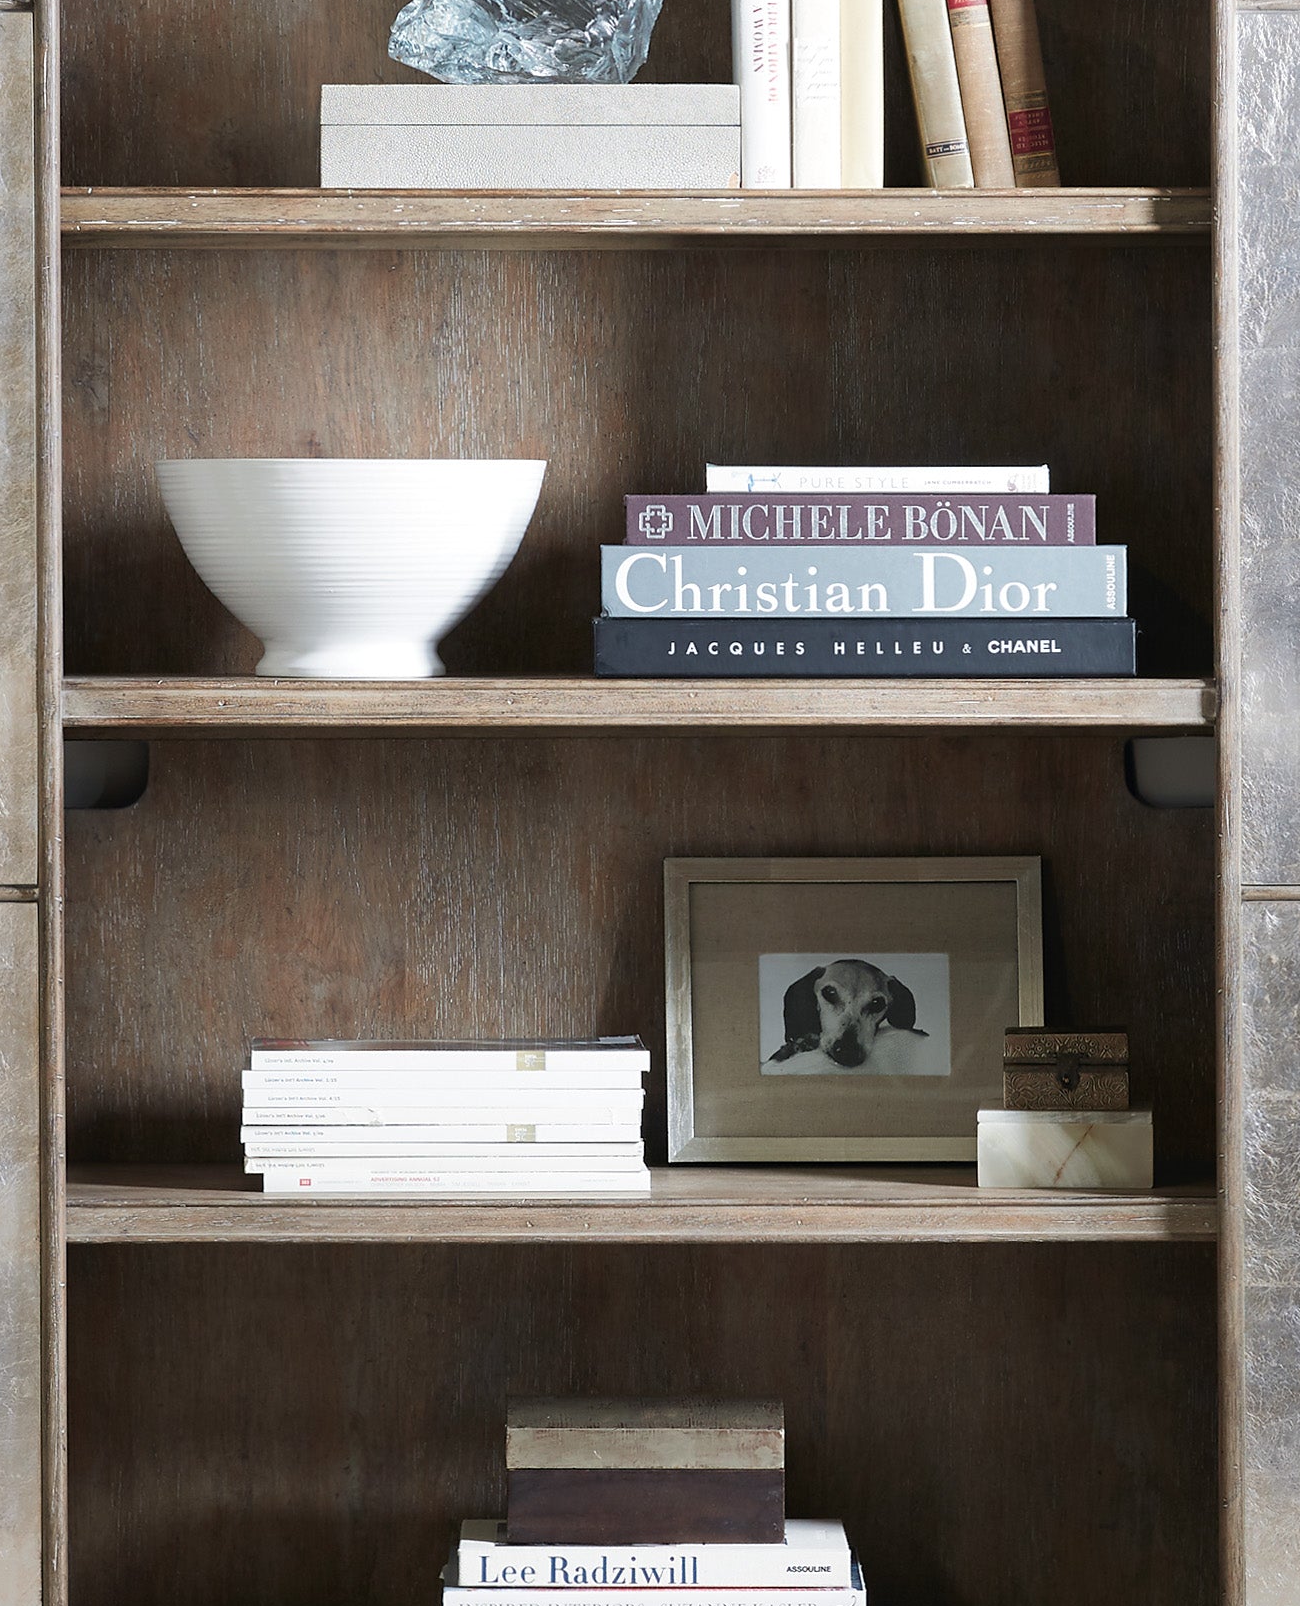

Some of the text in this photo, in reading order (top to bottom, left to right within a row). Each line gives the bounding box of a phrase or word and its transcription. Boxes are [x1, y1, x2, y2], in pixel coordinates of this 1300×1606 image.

[752, 5, 763, 73] A WOMAN
[767, 2, 778, 84] EDUCATION
[799, 477, 845, 489] PURE
[854, 477, 909, 489] STYLE
[686, 500, 1050, 542] MICHELE BÖNAN
[614, 551, 1058, 613] Christian Dior
[1106, 554, 1116, 610] ASSOULINE
[667, 640, 1061, 657] JACQUES HELLEU & CHANEL
[479, 1555, 699, 1585] Lee Radziwill
